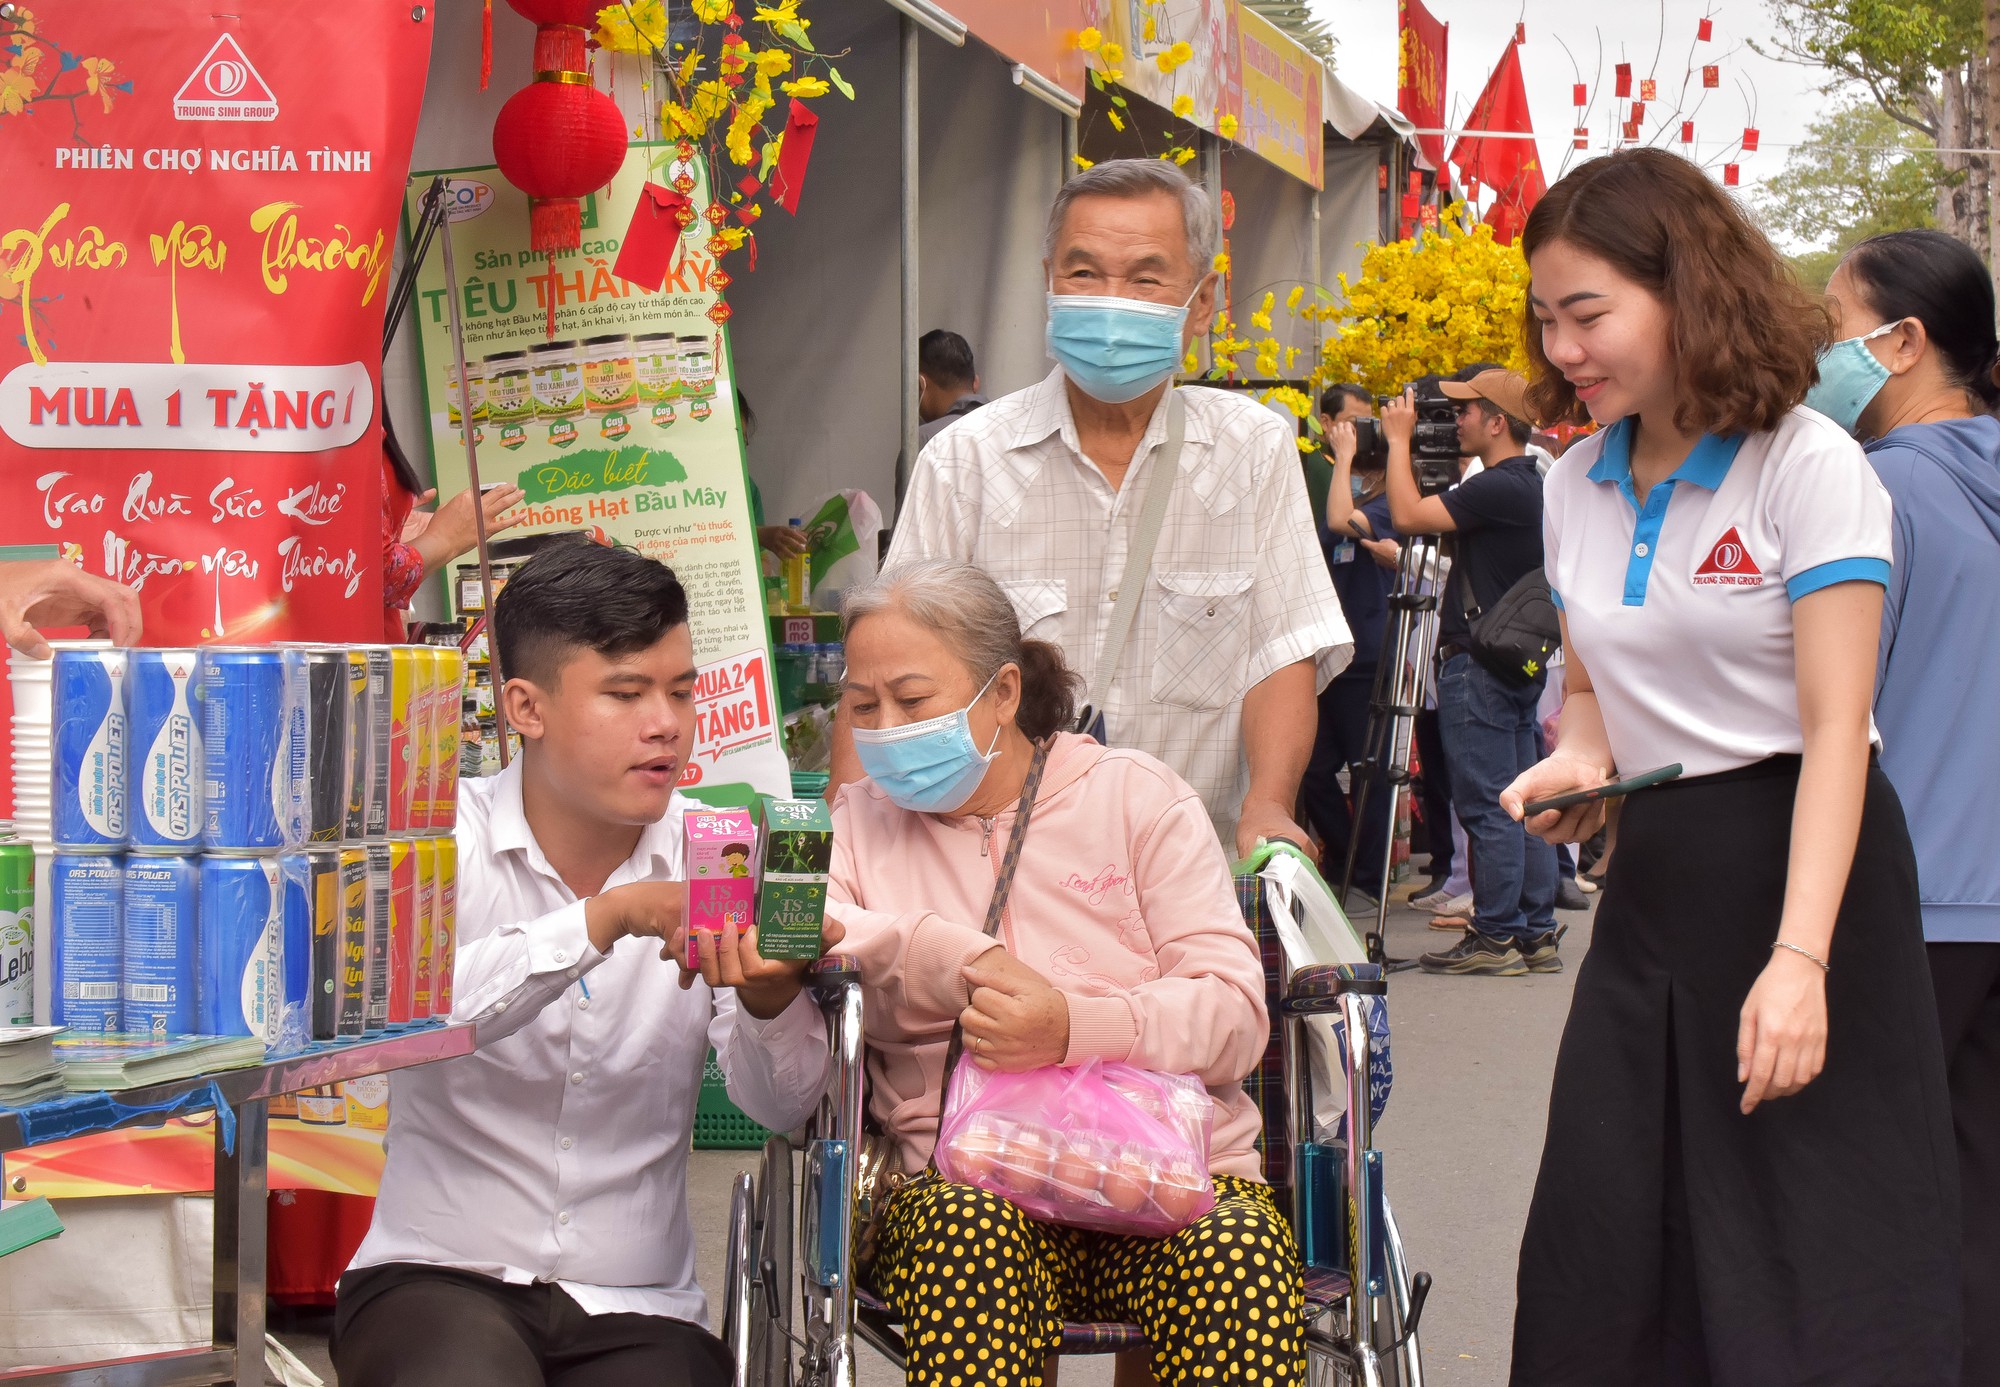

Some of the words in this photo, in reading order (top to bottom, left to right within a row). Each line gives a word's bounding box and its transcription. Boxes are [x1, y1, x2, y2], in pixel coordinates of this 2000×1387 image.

[177, 106, 215, 118] TRUONG
[218, 106, 241, 118] SINH
[244, 106, 276, 118] GROUP
[55, 144, 134, 170] PHIÊN
[143, 148, 202, 175] CHỢ
[210, 144, 299, 172] NGHĨA
[306, 147, 372, 172] TÌNH
[249, 201, 389, 307] Thương
[474, 249, 512, 270] Sản
[582, 238, 619, 256] cao
[421, 276, 518, 323] TÊU
[664, 250, 712, 293] KỲ
[465, 321, 494, 332] không
[496, 318, 511, 328] hạt
[513, 313, 531, 325] Bầu
[533, 311, 548, 322] Mâ
[555, 309, 577, 321] phân
[580, 306, 586, 316] 6
[588, 304, 604, 315] cấp
[606, 302, 618, 313] độ
[620, 303, 636, 312] cay
[639, 300, 649, 308] từ
[651, 297, 671, 308] thấp
[672, 296, 688, 306] đến
[689, 297, 706, 306] cao.
[467, 333, 484, 344] liền
[486, 331, 504, 341] như
[506, 328, 517, 337] ăn
[519, 326, 536, 337] kẹo
[562, 322, 579, 332] hạt,
[581, 319, 592, 328] ăn
[595, 316, 614, 326] khai
[616, 314, 627, 324] vị,
[629, 313, 640, 322] ăn
[642, 311, 662, 320] kèm
[664, 310, 682, 319] món
[28, 386, 143, 427] MUA
[164, 388, 182, 427] 1
[205, 382, 335, 437] TẶNG
[342, 385, 356, 425] 1
[553, 424, 571, 436] Cay
[605, 416, 623, 428] Cay
[504, 428, 520, 438] Cay
[537, 466, 595, 493] Đặc
[603, 450, 651, 485] biệt
[36, 470, 106, 529] Trao
[588, 497, 630, 520] Hạt
[634, 490, 677, 513] Bầu
[683, 487, 728, 508] Mây
[634, 528, 661, 539] Được
[663, 526, 671, 534] ví
[674, 524, 692, 534] như
[708, 519, 733, 530] thuốc
[636, 540, 645, 549] di
[647, 539, 671, 551] động
[673, 536, 689, 546] của
[691, 535, 707, 545] mọi
[709, 533, 737, 542] người,
[278, 535, 368, 599] Thương
[685, 563, 703, 572] dành
[704, 561, 718, 570] cho
[720, 560, 740, 570] người
[694, 572, 704, 580] du
[721, 569, 741, 579] người
[702, 580, 710, 588] di
[1719, 576, 1736, 585] SINH
[1738, 576, 1763, 586] GROUP
[694, 589, 715, 599] thuốc
[717, 588, 724, 596] di
[725, 587, 744, 597] động
[714, 598, 732, 607] ngay
[723, 623, 739, 632] nhai
[739, 623, 749, 631] và
[704, 635, 722, 645] từng
[723, 633, 736, 642] hạt
[737, 633, 750, 642] cay
[692, 667, 732, 700] MUA
[732, 663, 744, 688] 2
[696, 700, 755, 746] TẶNG
[744, 656, 770, 728] 1
[69, 869, 87, 878] ORS
[88, 869, 121, 879] POWER
[137, 870, 172, 880] POWER
[706, 885, 732, 900] TS
[694, 899, 749, 919] Anco
[780, 898, 803, 912] TS
[768, 910, 816, 927] Anco
